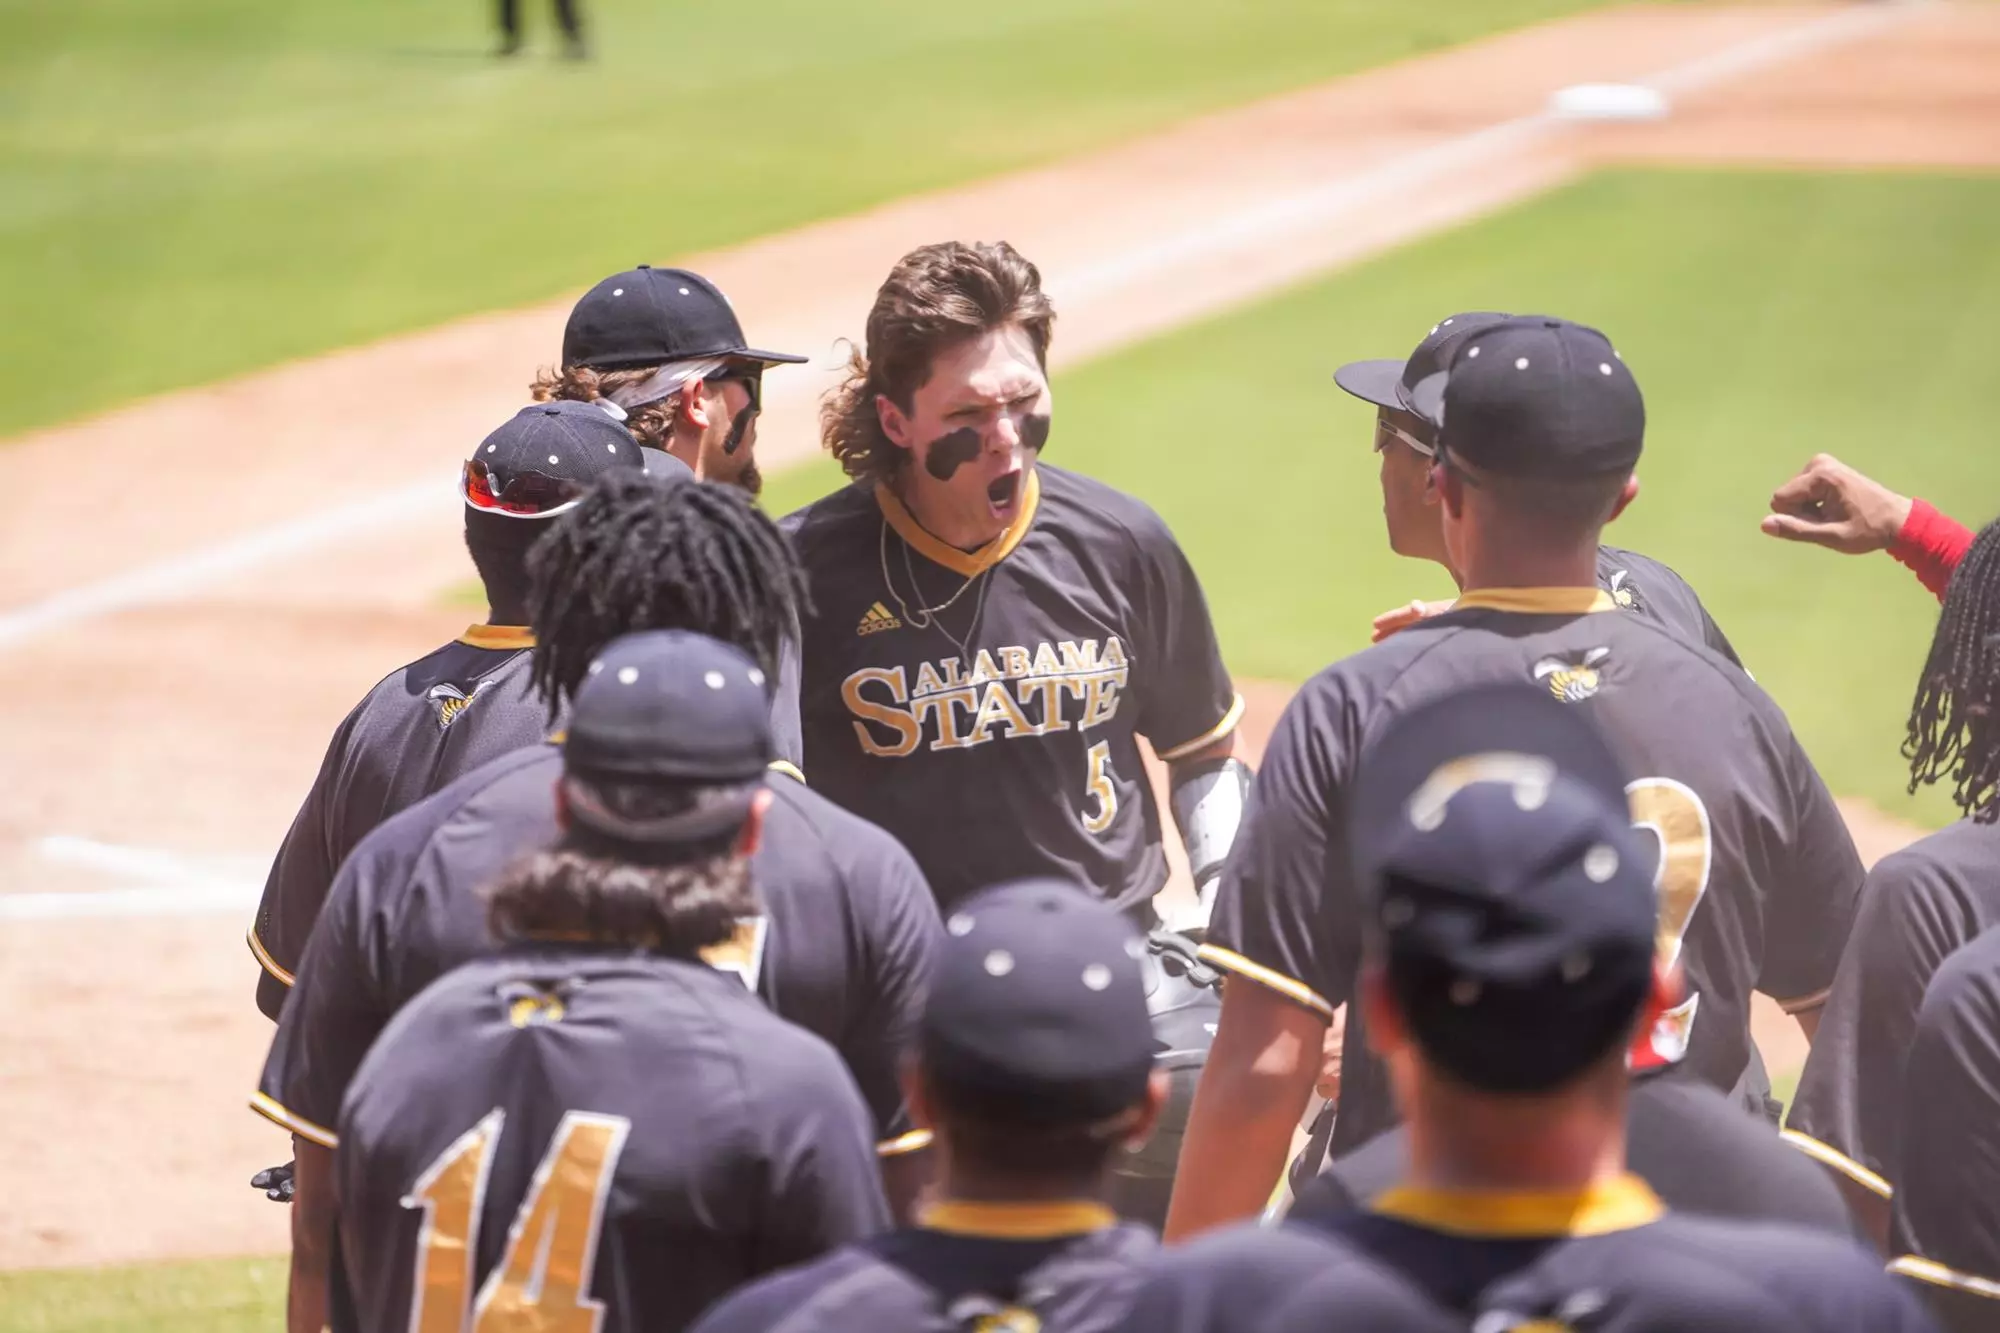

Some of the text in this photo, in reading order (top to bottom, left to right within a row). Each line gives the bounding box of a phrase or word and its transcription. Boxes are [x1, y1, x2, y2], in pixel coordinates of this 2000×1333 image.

[857, 618, 902, 636] adidas
[912, 635, 1129, 697] ALABAMA
[841, 664, 1129, 758] STATE
[1081, 739, 1118, 834] 5
[400, 1106, 632, 1333] 14
